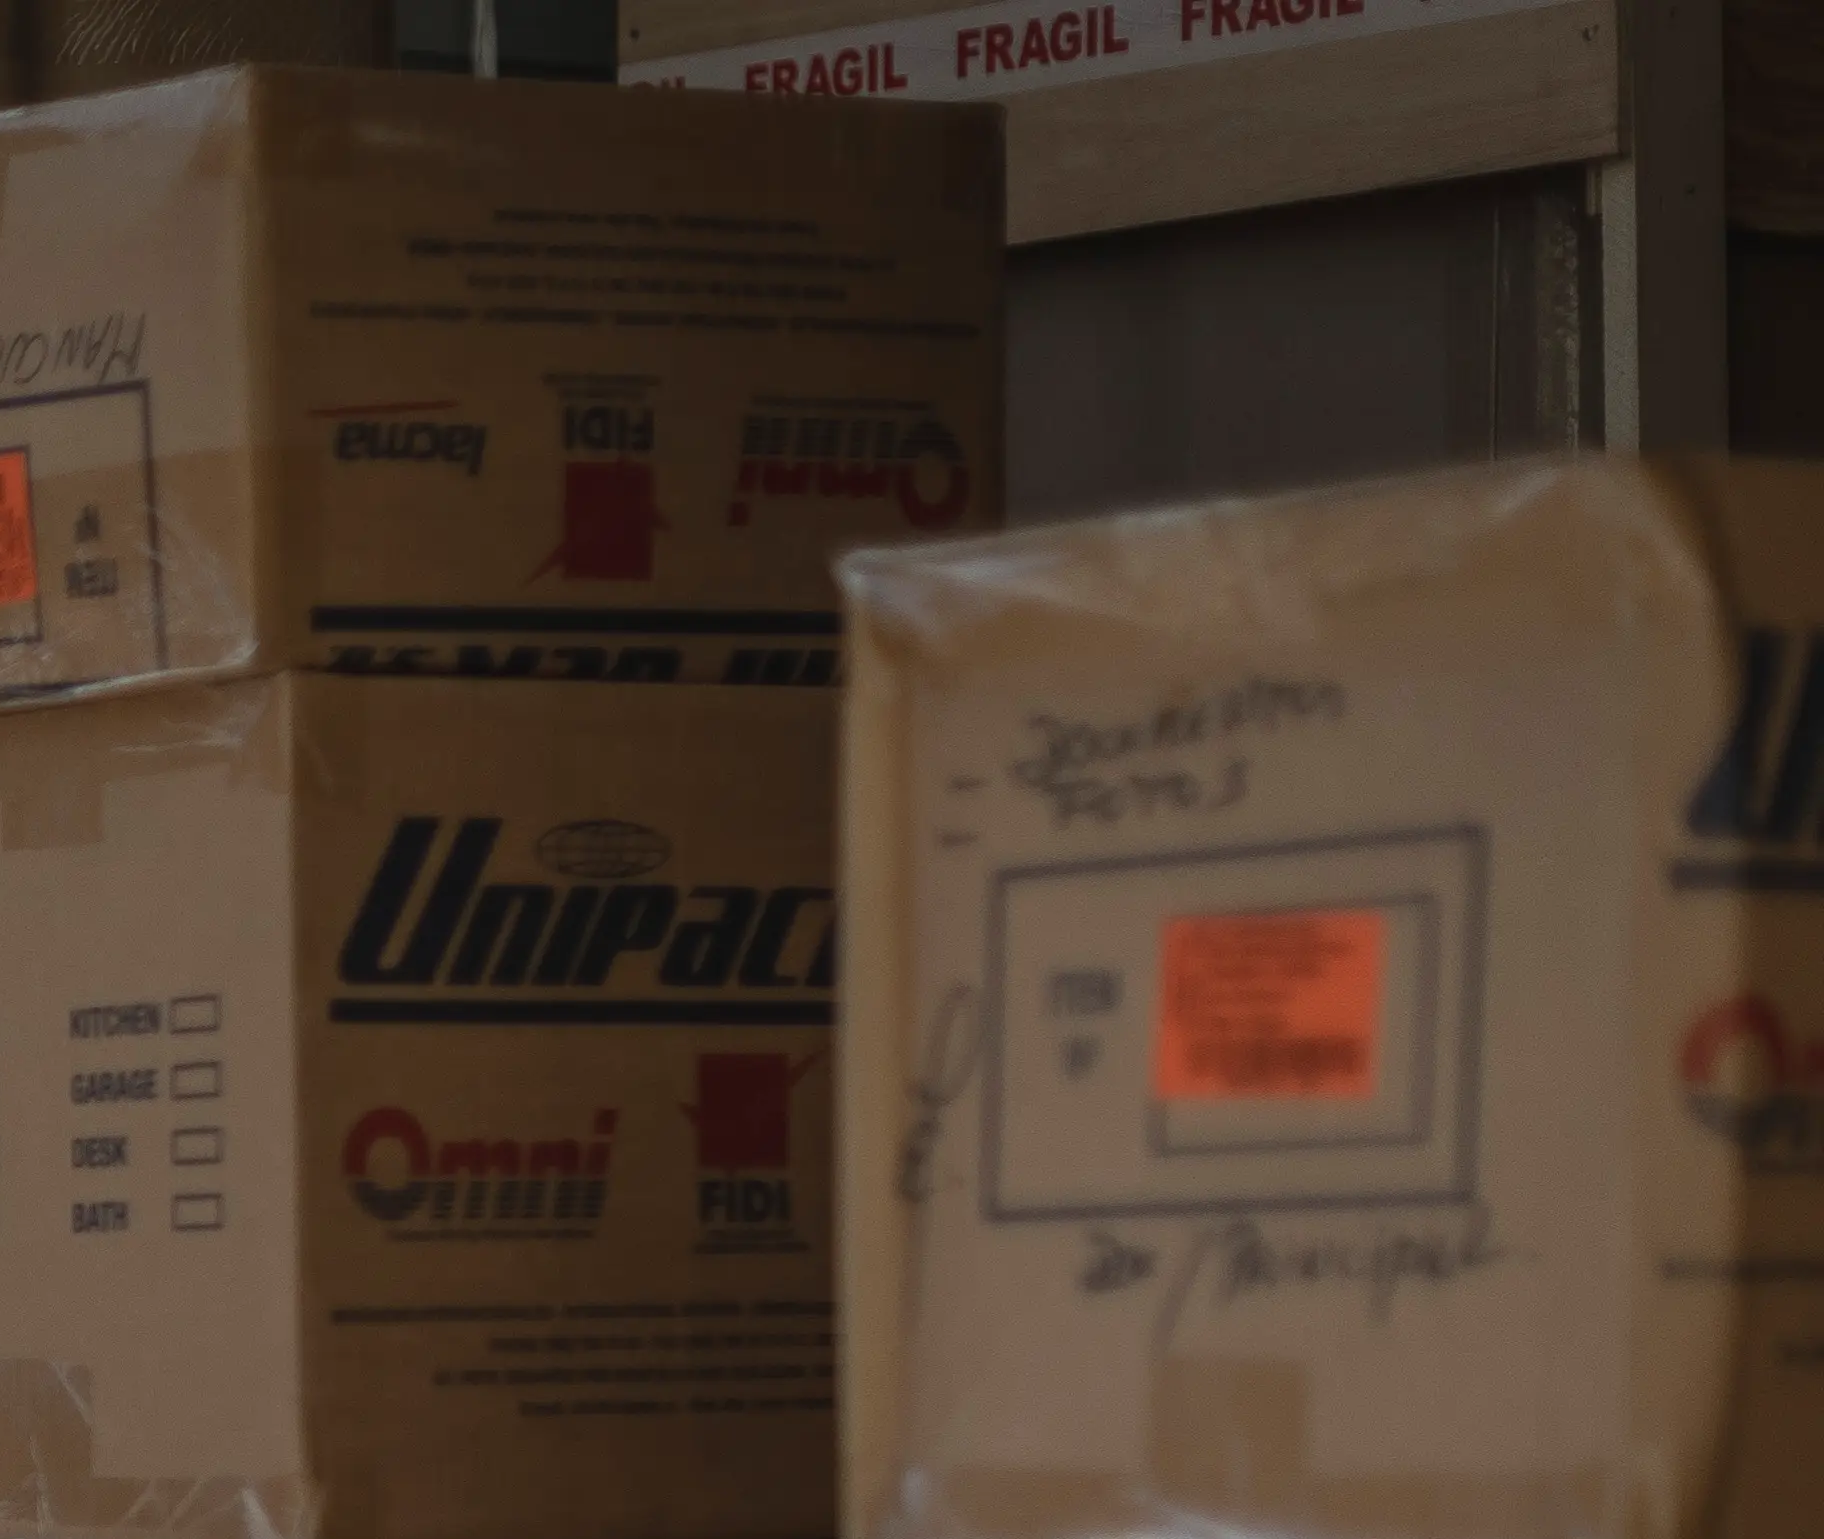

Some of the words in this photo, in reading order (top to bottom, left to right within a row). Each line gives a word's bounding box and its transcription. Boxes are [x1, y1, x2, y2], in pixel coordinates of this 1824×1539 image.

[745, 41, 908, 96] FRAGIL
[956, 5, 1130, 79] FRAGIL
[332, 420, 490, 477] lacma
[560, 406, 652, 455] FIDI
[726, 411, 970, 531] Omni
[69, 1004, 160, 1039] KITCHEN
[70, 1069, 159, 1105] GARAGE
[71, 1136, 128, 1169] DESK
[342, 1105, 620, 1223] Omni
[72, 1201, 129, 1234] BATH
[697, 1177, 792, 1224] FIDI
